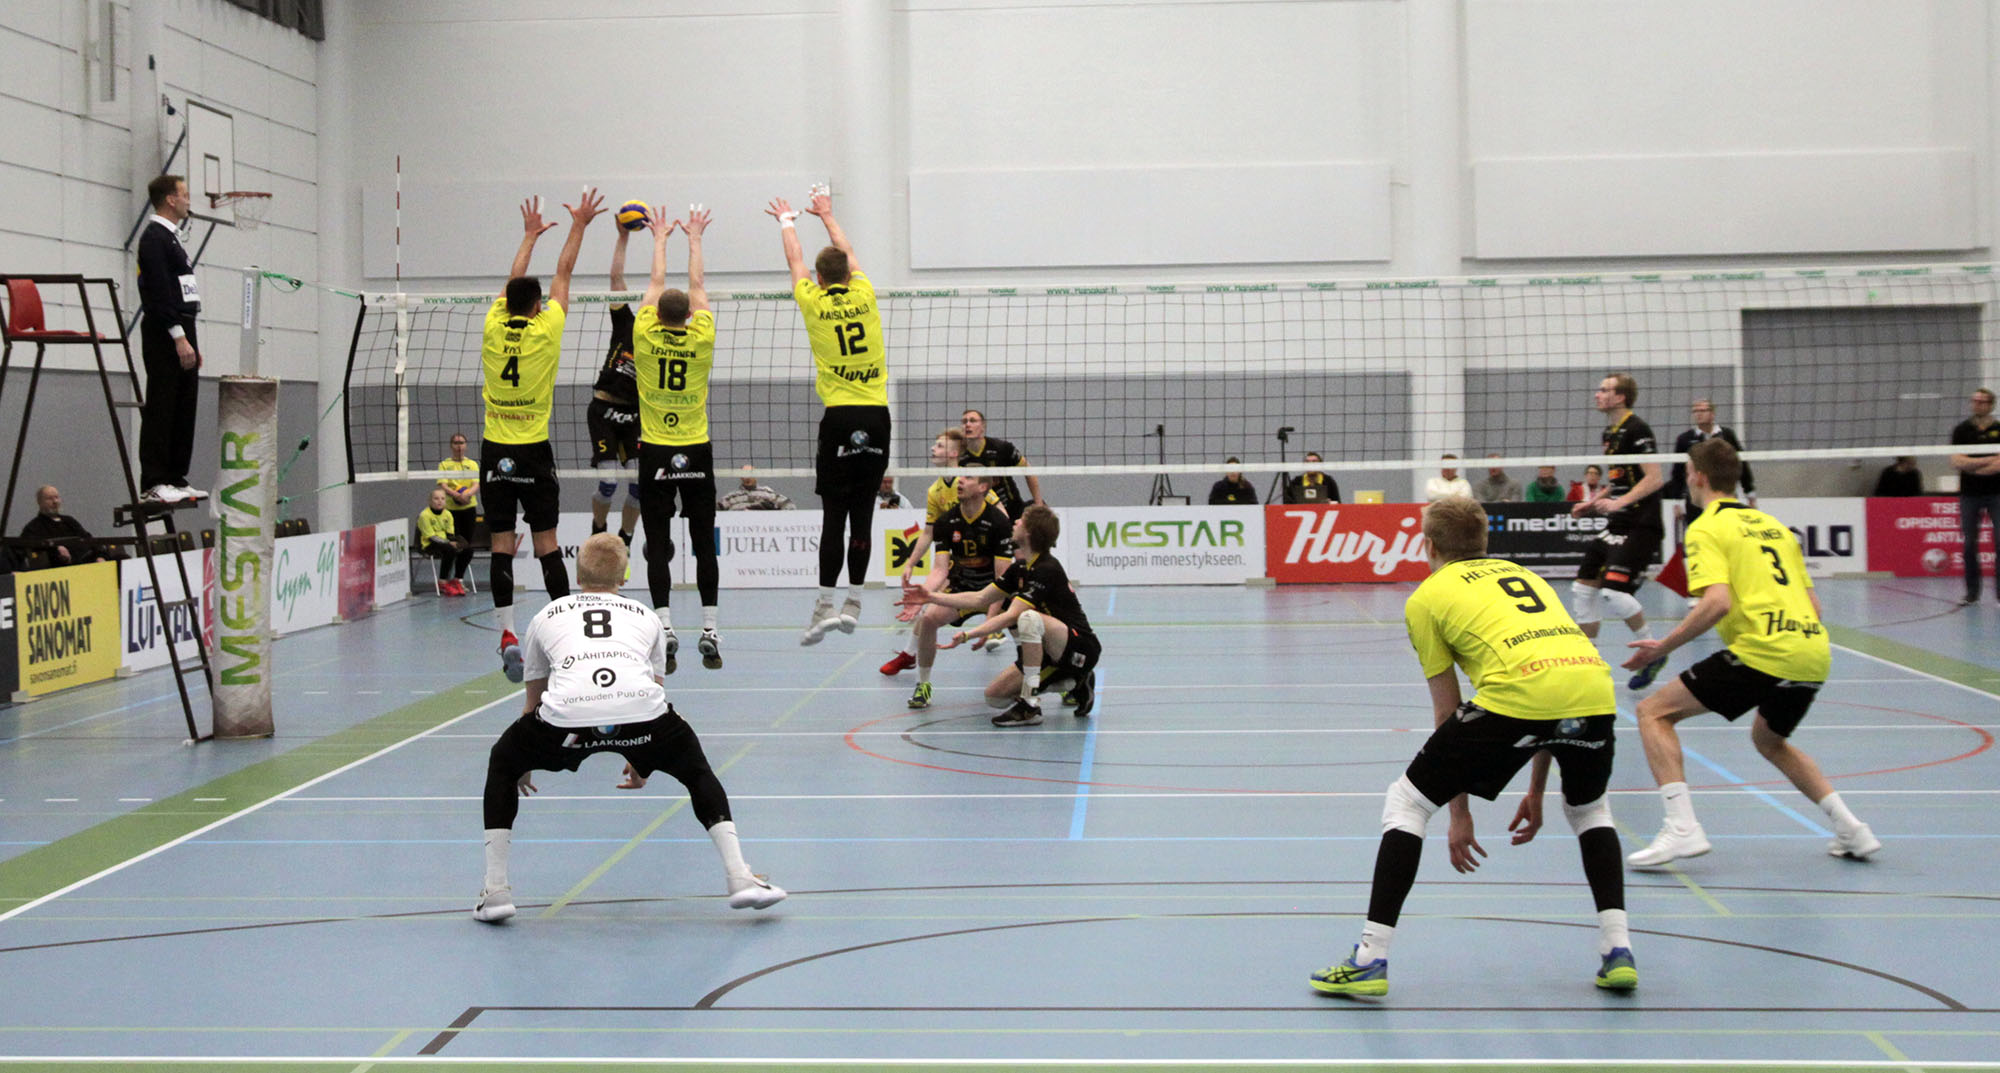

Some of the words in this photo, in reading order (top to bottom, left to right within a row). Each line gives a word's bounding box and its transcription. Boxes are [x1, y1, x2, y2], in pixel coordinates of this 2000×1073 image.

[834, 322, 868, 356] 12
[500, 356, 520, 387] 4
[658, 357, 687, 391] 18
[725, 525, 822, 533] TILINTARKASTUST
[1087, 520, 1245, 548] MESTAR
[1507, 513, 1609, 531] meditea
[221, 431, 261, 685] MESTAR
[726, 537, 780, 555] JUHA
[786, 537, 819, 553] TIS
[737, 565, 818, 576] www.tissari.f
[1087, 552, 1148, 570] Kumppani
[1152, 552, 1246, 569] menestykseen.
[1761, 545, 1788, 586] 3
[25, 580, 71, 623] SAVON
[1497, 576, 1546, 613] 9
[582, 609, 613, 638] 8
[28, 615, 92, 665] SANOMAT
[577, 651, 639, 662] LÄHITAPIOLA
[562, 693, 614, 705] Varkauden
[617, 690, 635, 698] Puu
[585, 734, 652, 749] LAAKKONEN
